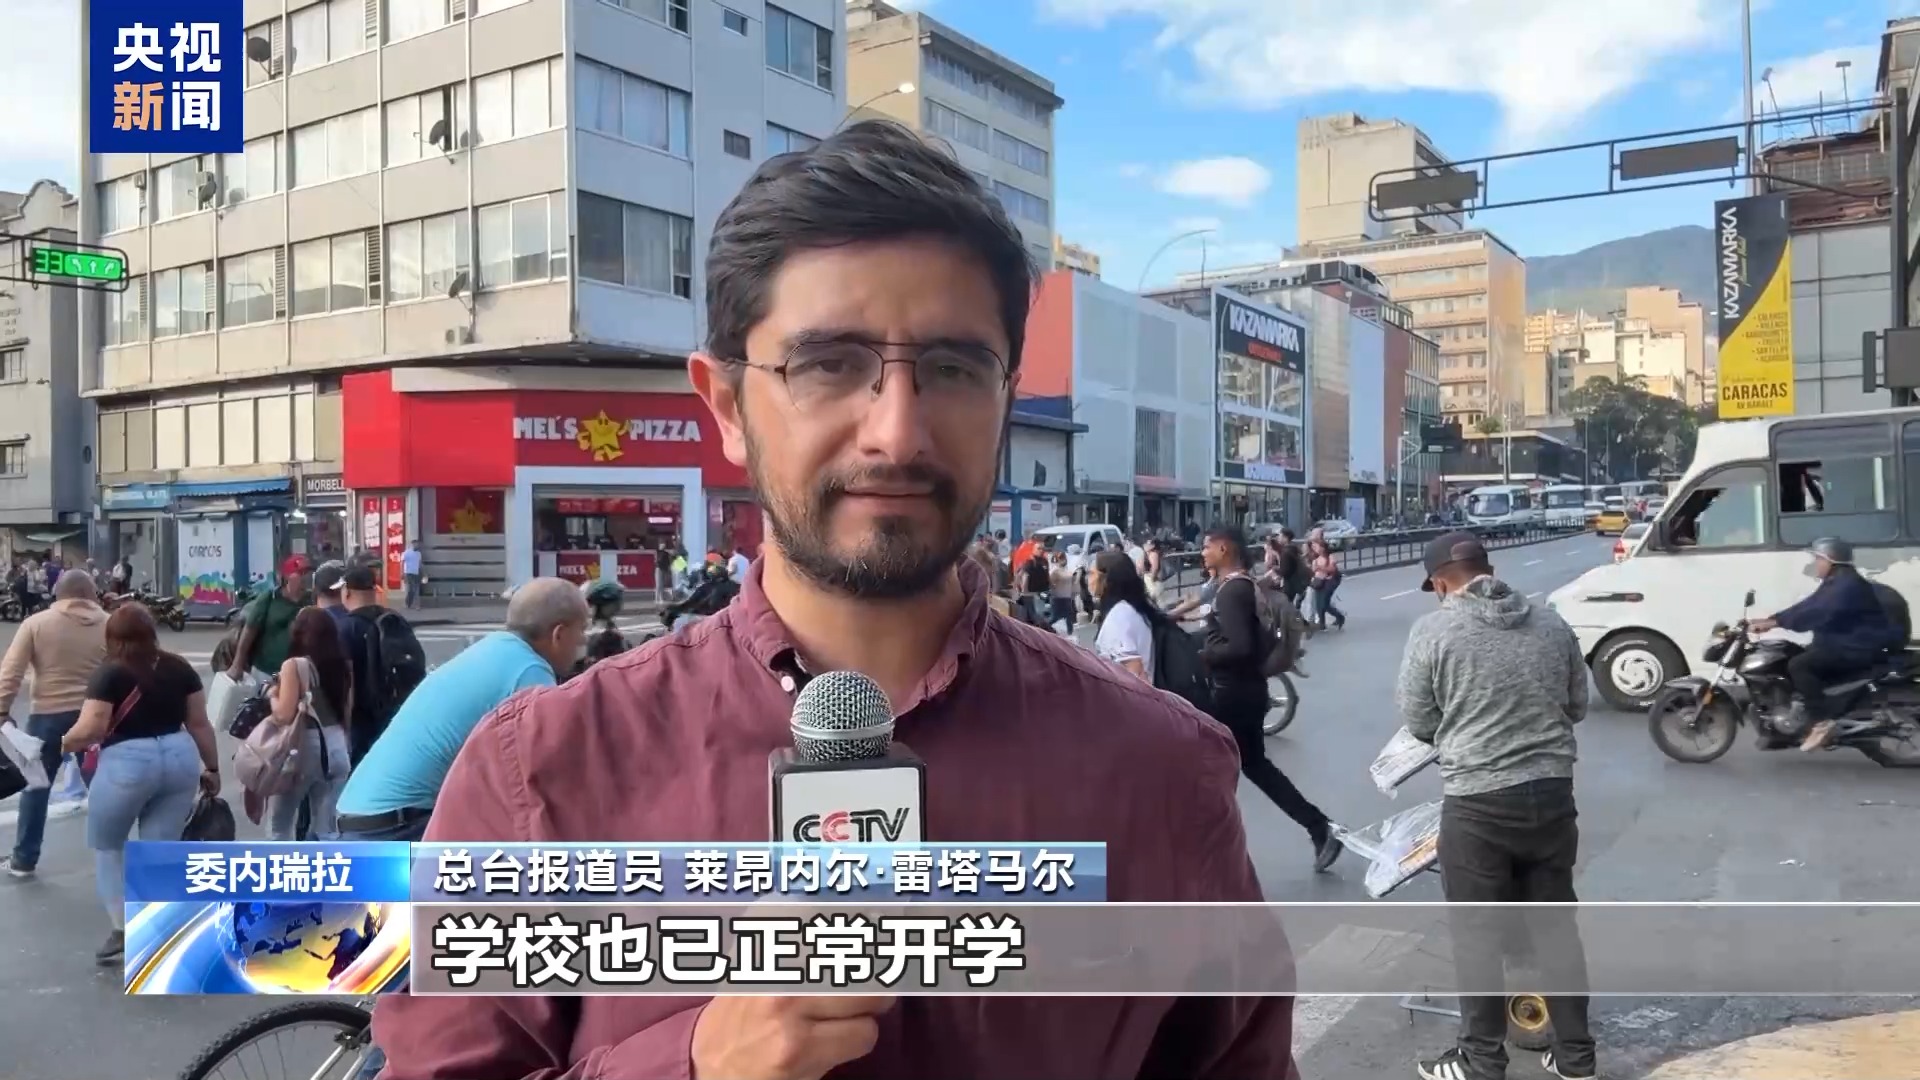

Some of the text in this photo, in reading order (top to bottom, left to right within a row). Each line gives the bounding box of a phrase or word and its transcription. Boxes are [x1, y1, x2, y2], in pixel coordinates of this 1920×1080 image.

[35, 250, 63, 274] 33
[1721, 206, 1740, 320] KAZAMARKA
[1229, 303, 1300, 353] KAZAMARKA
[1722, 382, 1788, 402] CARACAS
[629, 420, 701, 442] PIZZA
[793, 808, 910, 842] CCTV
